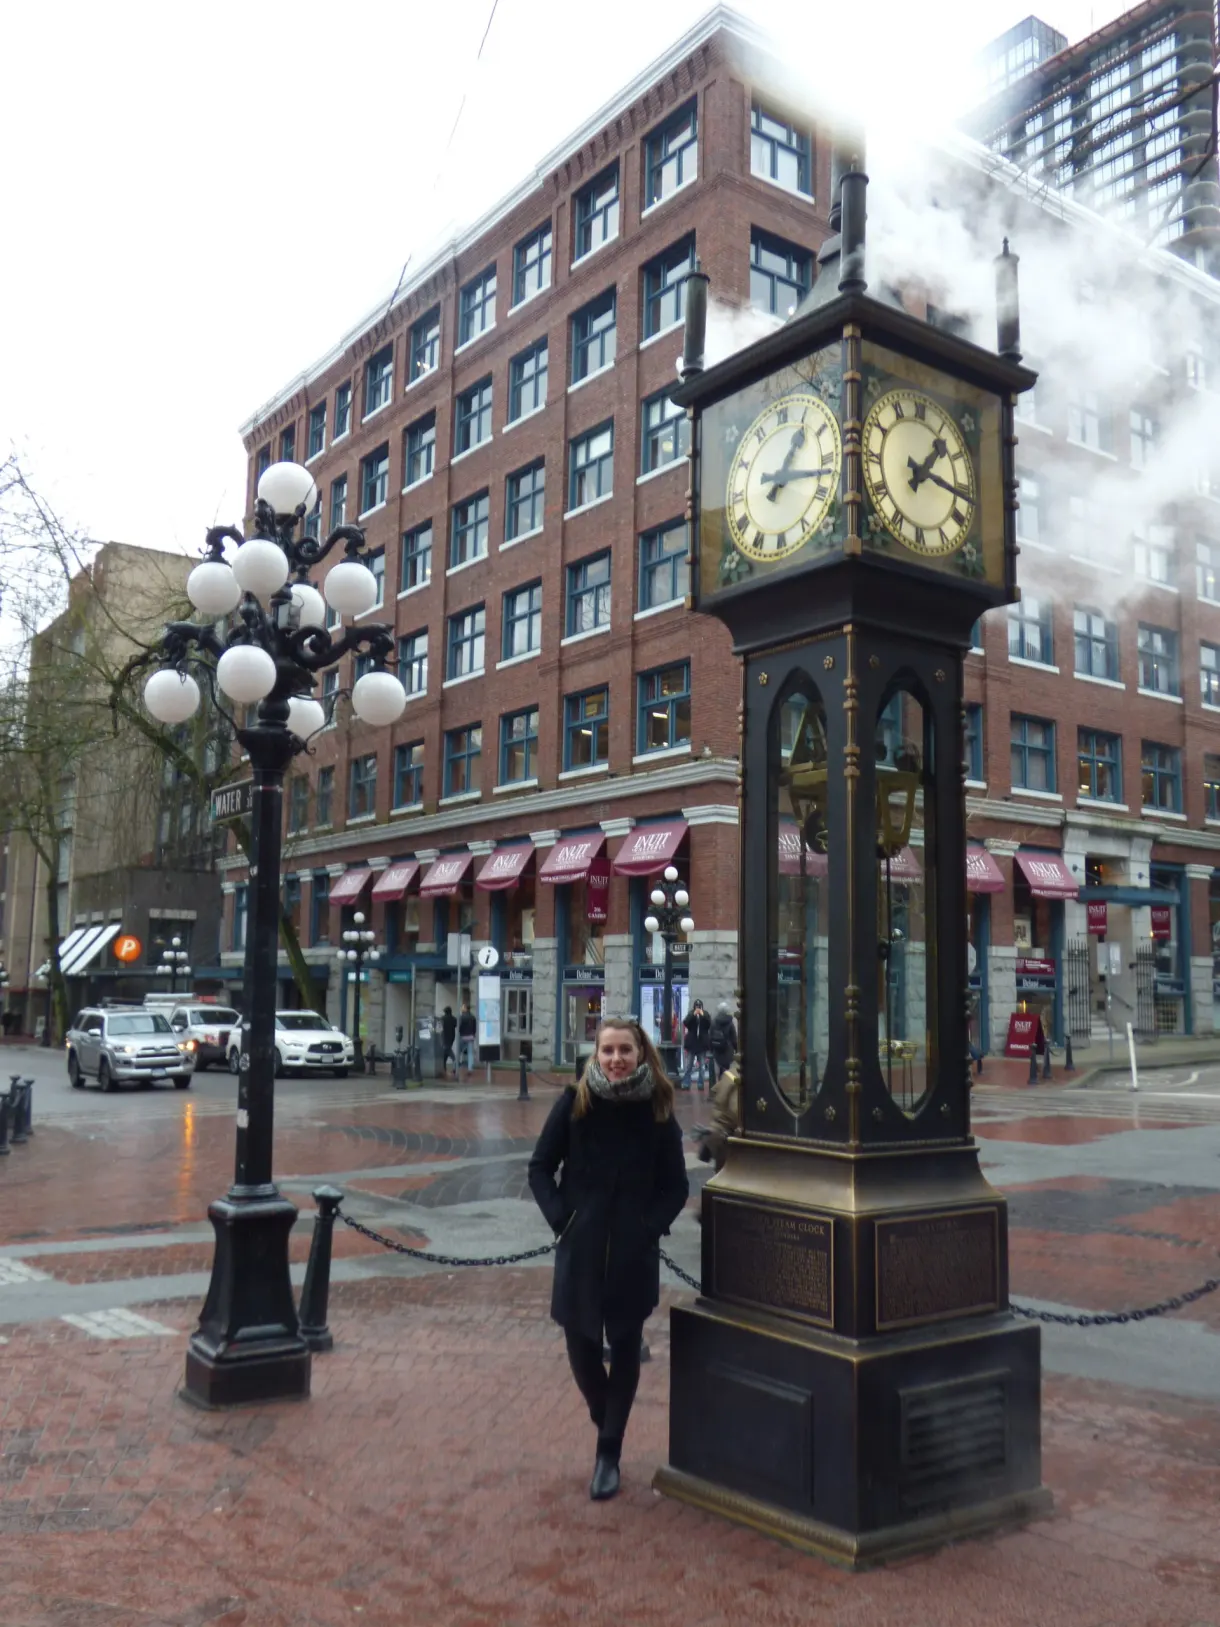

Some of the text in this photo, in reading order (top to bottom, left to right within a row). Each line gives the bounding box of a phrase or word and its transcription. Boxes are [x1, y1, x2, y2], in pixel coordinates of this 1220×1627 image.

[215, 789, 241, 817] WATER
[634, 832, 672, 851] INUIT
[493, 853, 522, 870] INUIT
[557, 843, 591, 862] INUIT
[1028, 861, 1062, 879] INUIT
[590, 876, 609, 885] INUIT
[1089, 905, 1106, 914] INUIT
[121, 939, 136, 957] P
[798, 1223, 825, 1235] CLOCK
